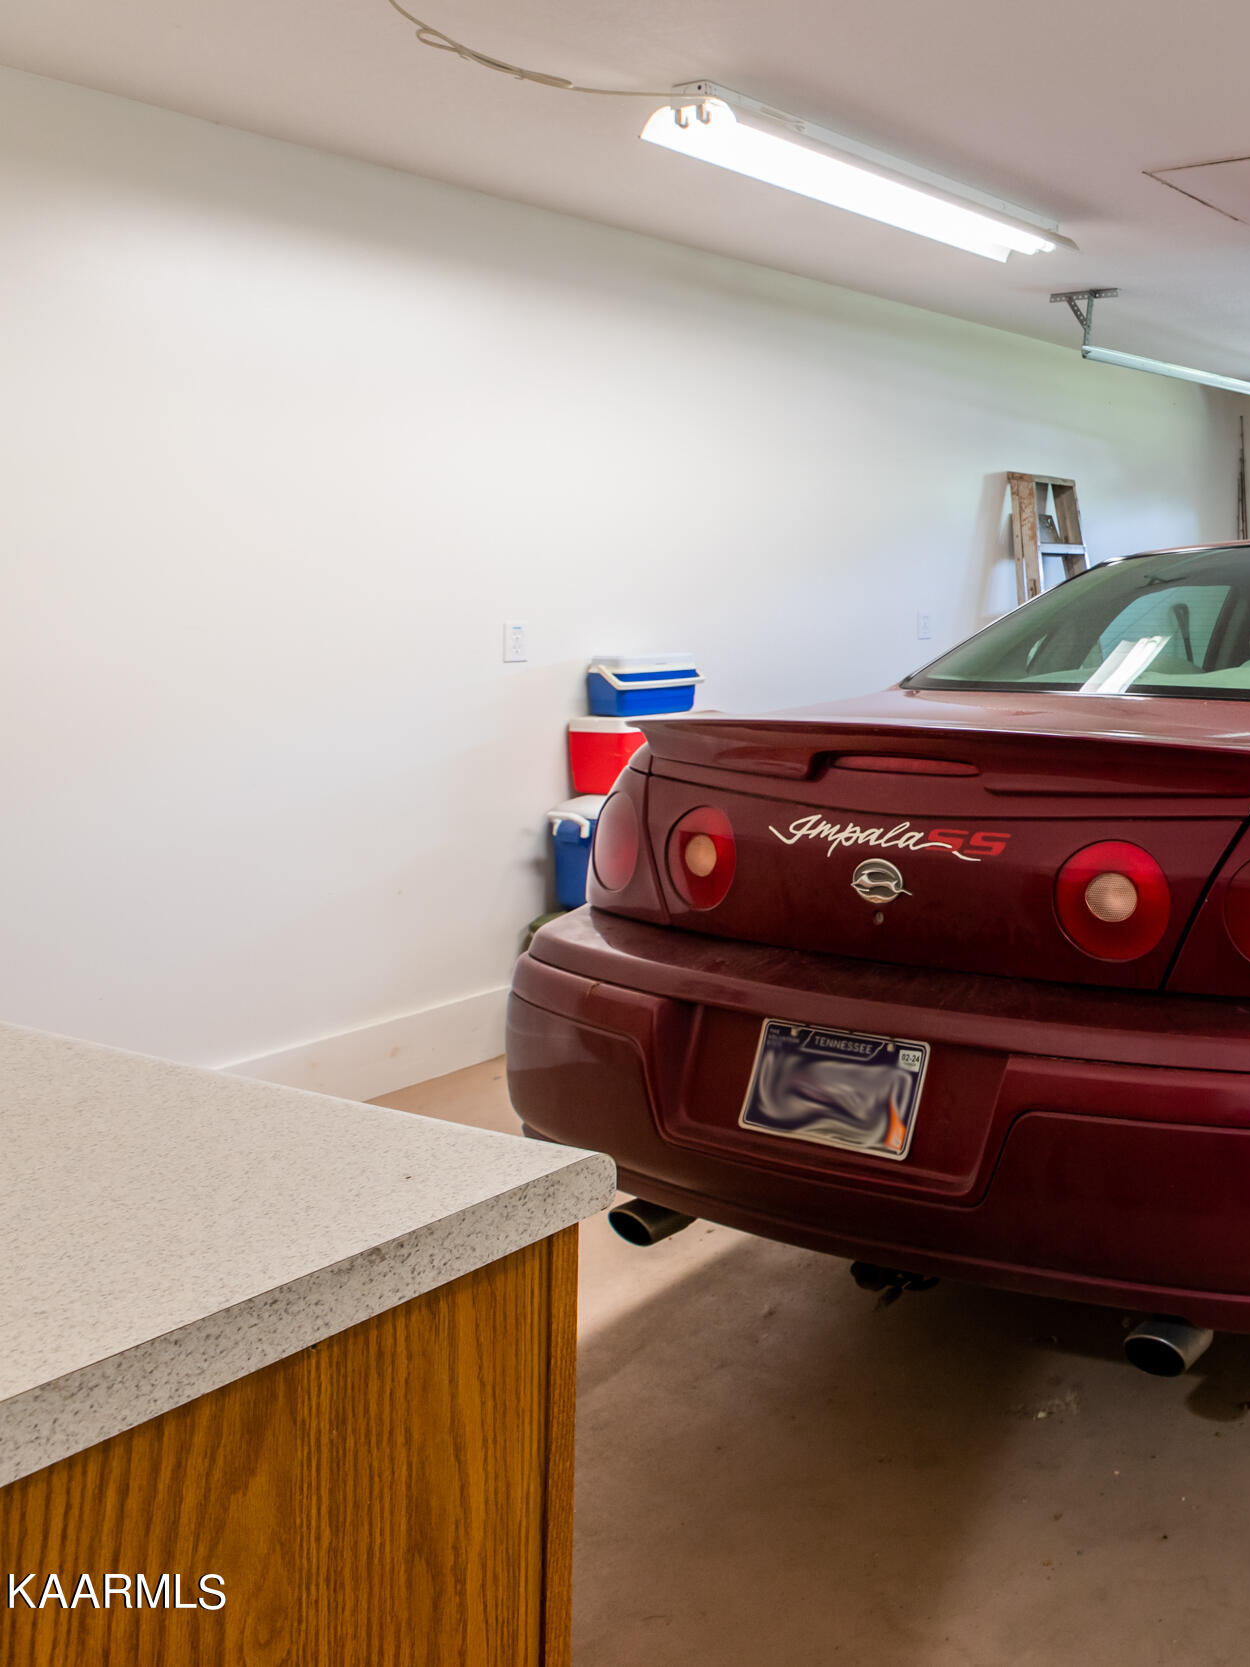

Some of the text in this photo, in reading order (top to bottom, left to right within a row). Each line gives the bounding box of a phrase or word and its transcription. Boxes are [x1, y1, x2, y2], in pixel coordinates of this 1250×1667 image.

[769, 814, 1012, 861] Impala SS
[814, 1035, 873, 1055] TENNESSEE
